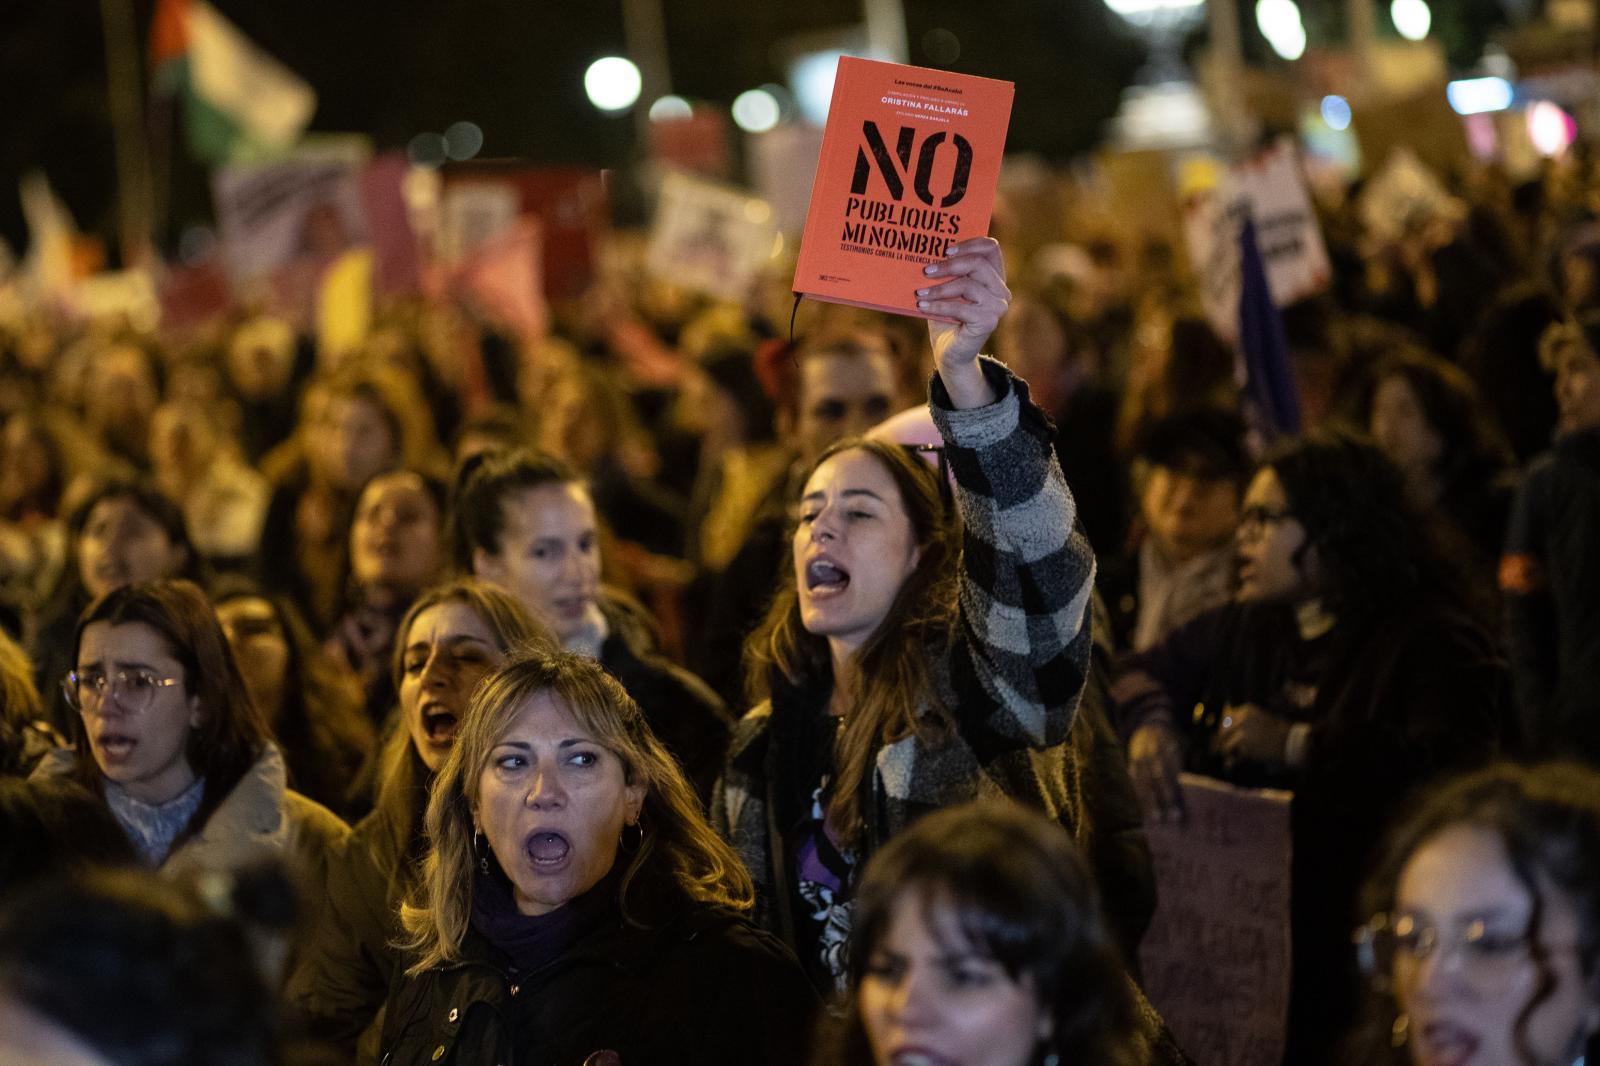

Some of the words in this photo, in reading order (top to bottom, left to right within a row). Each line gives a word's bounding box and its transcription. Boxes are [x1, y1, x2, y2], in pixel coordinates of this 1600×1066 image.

[881, 96, 922, 109] CRISTINA
[923, 102, 969, 117] FALLARÁS
[850, 120, 974, 208] NO
[845, 197, 961, 235] PUBLIQUES
[840, 243, 874, 255] TESTIMONIOS
[875, 248, 895, 258] CONTRA
[904, 255, 931, 264] VIOLENCIA
[842, 221, 868, 244] MI
[868, 226, 957, 258] NOMBRE
